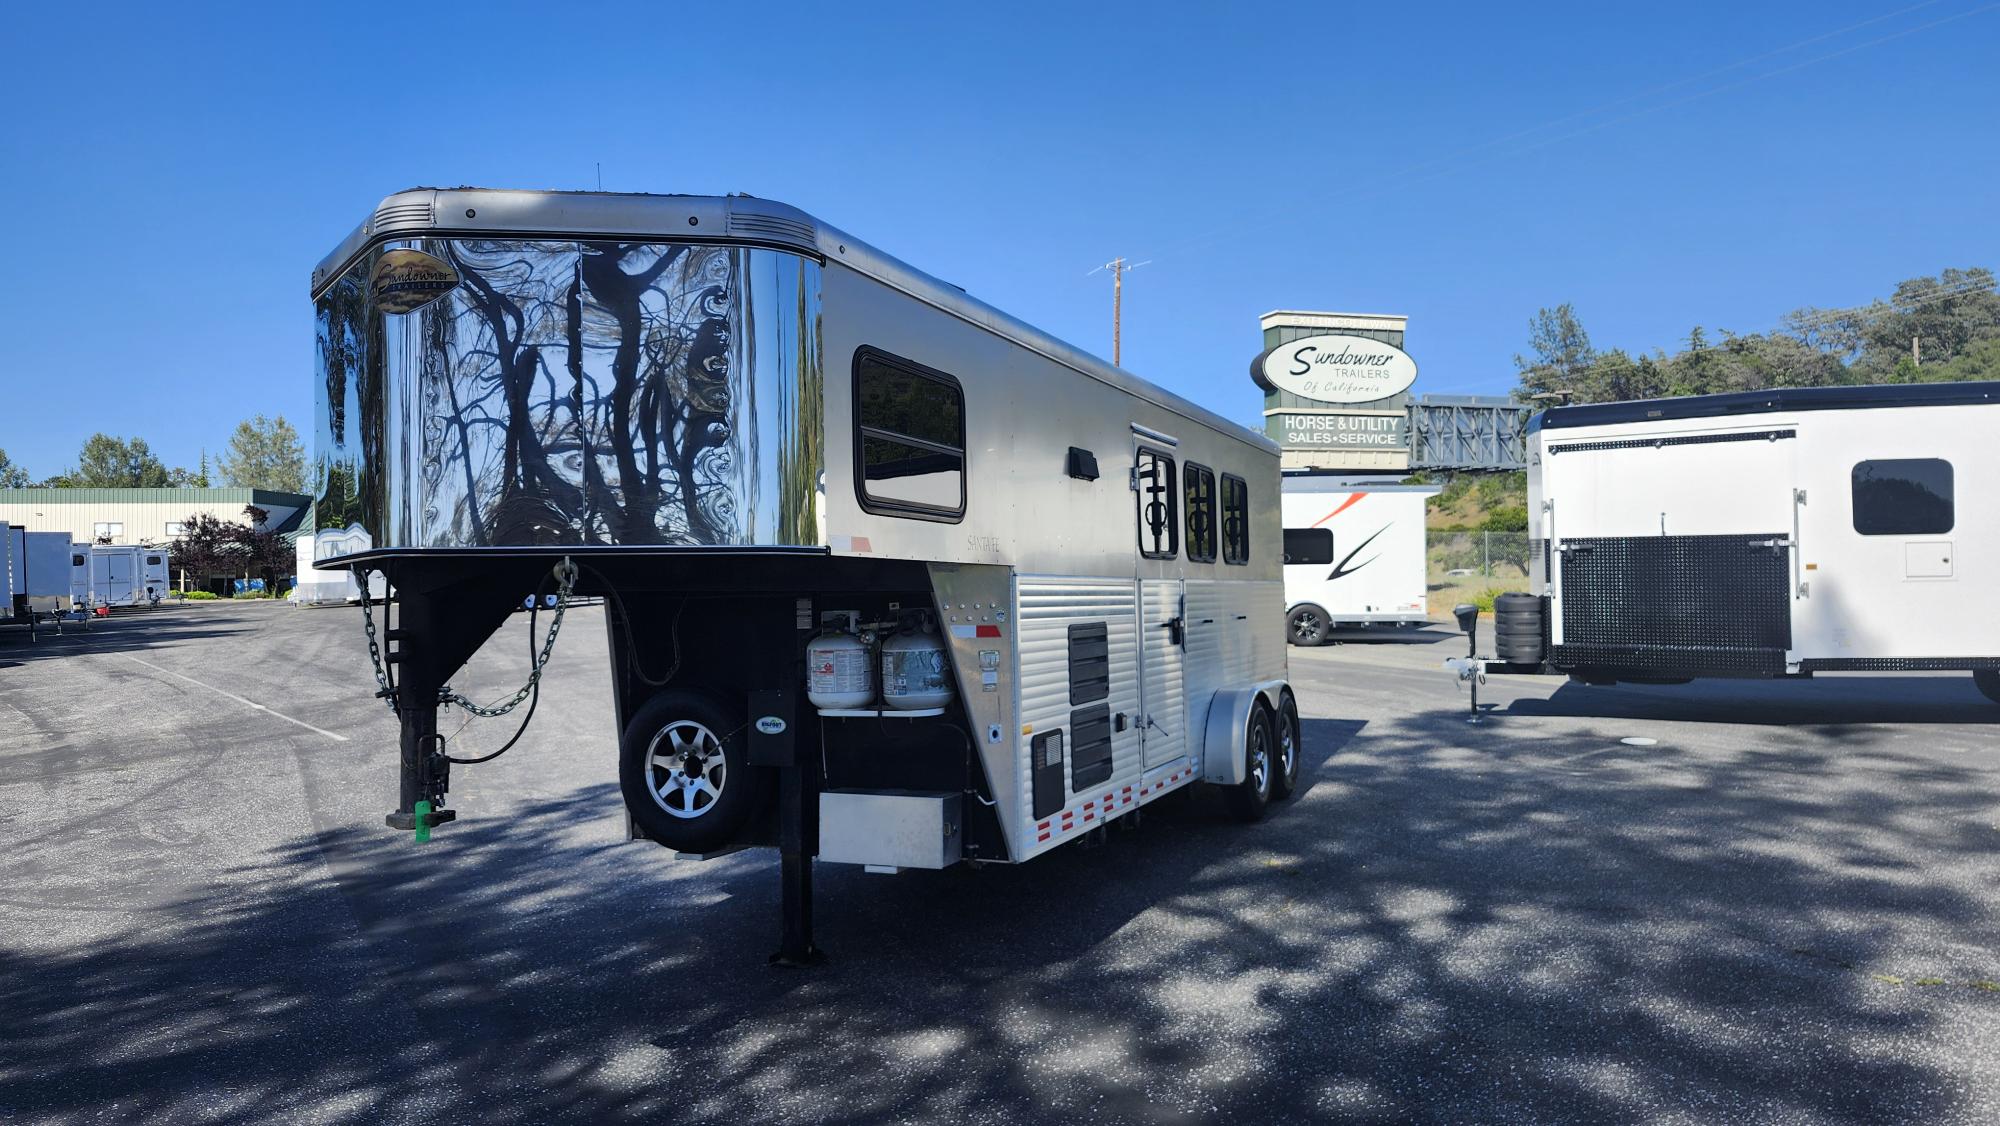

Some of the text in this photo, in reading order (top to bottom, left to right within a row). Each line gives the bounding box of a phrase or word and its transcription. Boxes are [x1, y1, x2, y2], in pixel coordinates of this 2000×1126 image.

[1289, 345, 1394, 376] Sundowner
[1335, 368, 1391, 379] TRAILERS
[1303, 381, 1380, 395] Of California
[1285, 416, 1399, 431] HORSE & UTILITY
